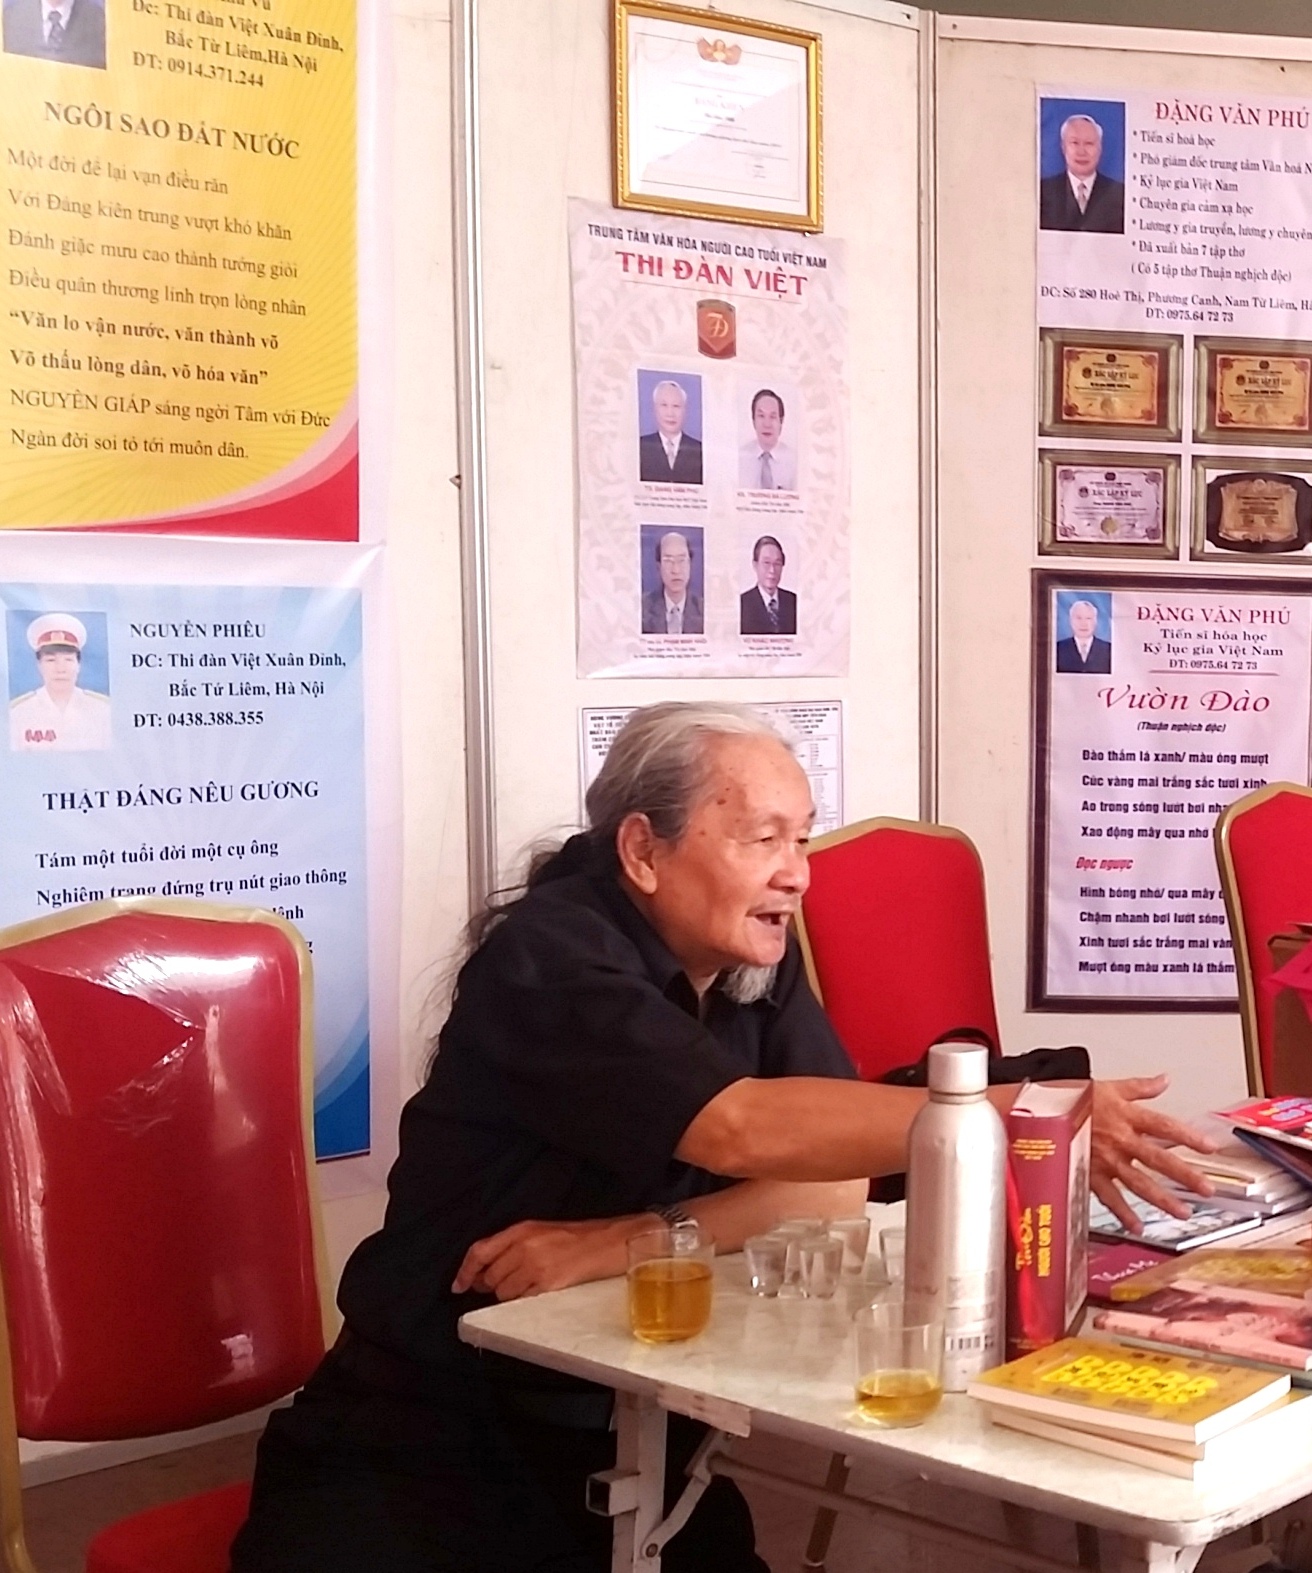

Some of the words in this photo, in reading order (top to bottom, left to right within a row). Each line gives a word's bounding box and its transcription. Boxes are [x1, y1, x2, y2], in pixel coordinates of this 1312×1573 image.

[165, 3, 191, 21] Thi
[196, 10, 224, 28] đàn
[229, 16, 258, 36] Việt
[264, 22, 302, 42] Xuân
[166, 29, 193, 49] Bắc
[293, 54, 318, 74] Nội
[133, 51, 162, 70] ĐT:
[168, 57, 264, 88] 0914.371.244
[1156, 98, 1213, 125] ĐẶNG
[1219, 103, 1260, 126] VĂN
[1268, 106, 1310, 129] PHÚ
[43, 101, 113, 131] NGÔI
[120, 113, 171, 139] SAO
[178, 121, 227, 148] ĐẤT
[232, 130, 301, 160] NƯỚC
[1156, 176, 1172, 191] lục
[1174, 179, 1190, 191] gia
[1192, 177, 1213, 194] Việt
[1215, 180, 1239, 191] Nam
[8, 188, 40, 210] Với
[98, 200, 132, 221] kiên
[138, 208, 180, 230] trung
[184, 214, 219, 233] vượt
[224, 217, 252, 236] khó
[257, 221, 292, 242] khăn
[1139, 196, 1178, 212] Chuyên
[1181, 201, 1196, 212] gia
[1236, 202, 1254, 218] học
[588, 223, 624, 240] TRUNG
[626, 229, 650, 244] TÂM
[652, 232, 674, 247] VĂN
[676, 235, 698, 251] HÓA
[734, 245, 755, 259] CAO
[782, 252, 803, 266] VIỆT
[805, 255, 827, 269] NAM
[615, 251, 664, 277] THI
[672, 255, 733, 287] ĐÀN
[744, 267, 808, 299] VIỆT
[1166, 309, 1204, 321] 0975.64
[1207, 311, 1219, 322] 72
[1222, 311, 1234, 322] 73
[64, 314, 79, 331] lo
[86, 317, 116, 339] vận
[123, 322, 170, 341] nước,
[175, 326, 204, 344] văn
[210, 329, 256, 349] thành
[261, 334, 279, 350] võ
[10, 349, 36, 368] Võ
[42, 348, 81, 372] thấu
[87, 355, 125, 377] lòng
[130, 360, 168, 380] dân,
[172, 364, 191, 380] võ
[196, 364, 225, 383] hóa
[10, 428, 57, 449] Ngàn
[62, 431, 88, 450] đời
[94, 435, 117, 451] soi
[144, 437, 164, 454] tới
[170, 440, 214, 457] muôn
[218, 442, 249, 459] dân.
[1137, 603, 1194, 625] ĐẶNG
[1201, 603, 1242, 624] VĂN
[1250, 606, 1291, 625] PHÚ
[1160, 628, 1192, 640] Tiến
[1212, 629, 1238, 641] hóa
[1243, 631, 1267, 643] học
[131, 653, 164, 668] ĐC:
[167, 653, 194, 667] Thi
[199, 653, 227, 667] đàn
[231, 653, 261, 670] Việt
[265, 652, 304, 667] Xuân
[1167, 643, 1188, 657] lục
[1193, 644, 1214, 656] gia
[1218, 645, 1246, 658] Việt
[1252, 646, 1284, 657] Nam
[1190, 660, 1229, 670] 0975.64
[1232, 661, 1244, 670] 72
[1246, 661, 1258, 671] 73
[169, 679, 197, 698] Bắc
[229, 681, 271, 697] Liêm,
[275, 681, 296, 695] Hà
[300, 681, 324, 698] Nội
[1097, 683, 1189, 710] Vườn
[1200, 689, 1270, 712] Đào
[133, 713, 163, 728] ĐT:
[167, 711, 264, 727] 0438.388.355
[1082, 749, 1103, 761] Đào
[1140, 750, 1150, 762] lá
[1154, 751, 1186, 763] xanh/
[1189, 752, 1213, 763] màu
[1240, 753, 1269, 767] mượt
[42, 788, 109, 814] THẬT
[116, 784, 182, 808] ĐÁNG
[189, 781, 234, 804] NÊU
[240, 780, 320, 800] GƯƠNG
[35, 851, 77, 869] Tám
[83, 849, 115, 868] một
[121, 842, 154, 863] tuổi
[160, 845, 186, 861] đời
[191, 842, 222, 861] một
[227, 844, 246, 860] cụ
[250, 839, 279, 858] ông
[36, 886, 105, 909] Nghiêm
[162, 880, 205, 897] đứng
[209, 878, 234, 895] trụ
[239, 873, 265, 890] nút
[269, 872, 301, 891] giao
[305, 868, 347, 886] thông
[1080, 912, 1111, 924] Chậm
[1115, 913, 1149, 923] nhanh
[1198, 913, 1225, 925] sóng
[1079, 961, 1107, 974] Mượt
[1134, 962, 1158, 973] màu
[1162, 962, 1189, 973] xanh
